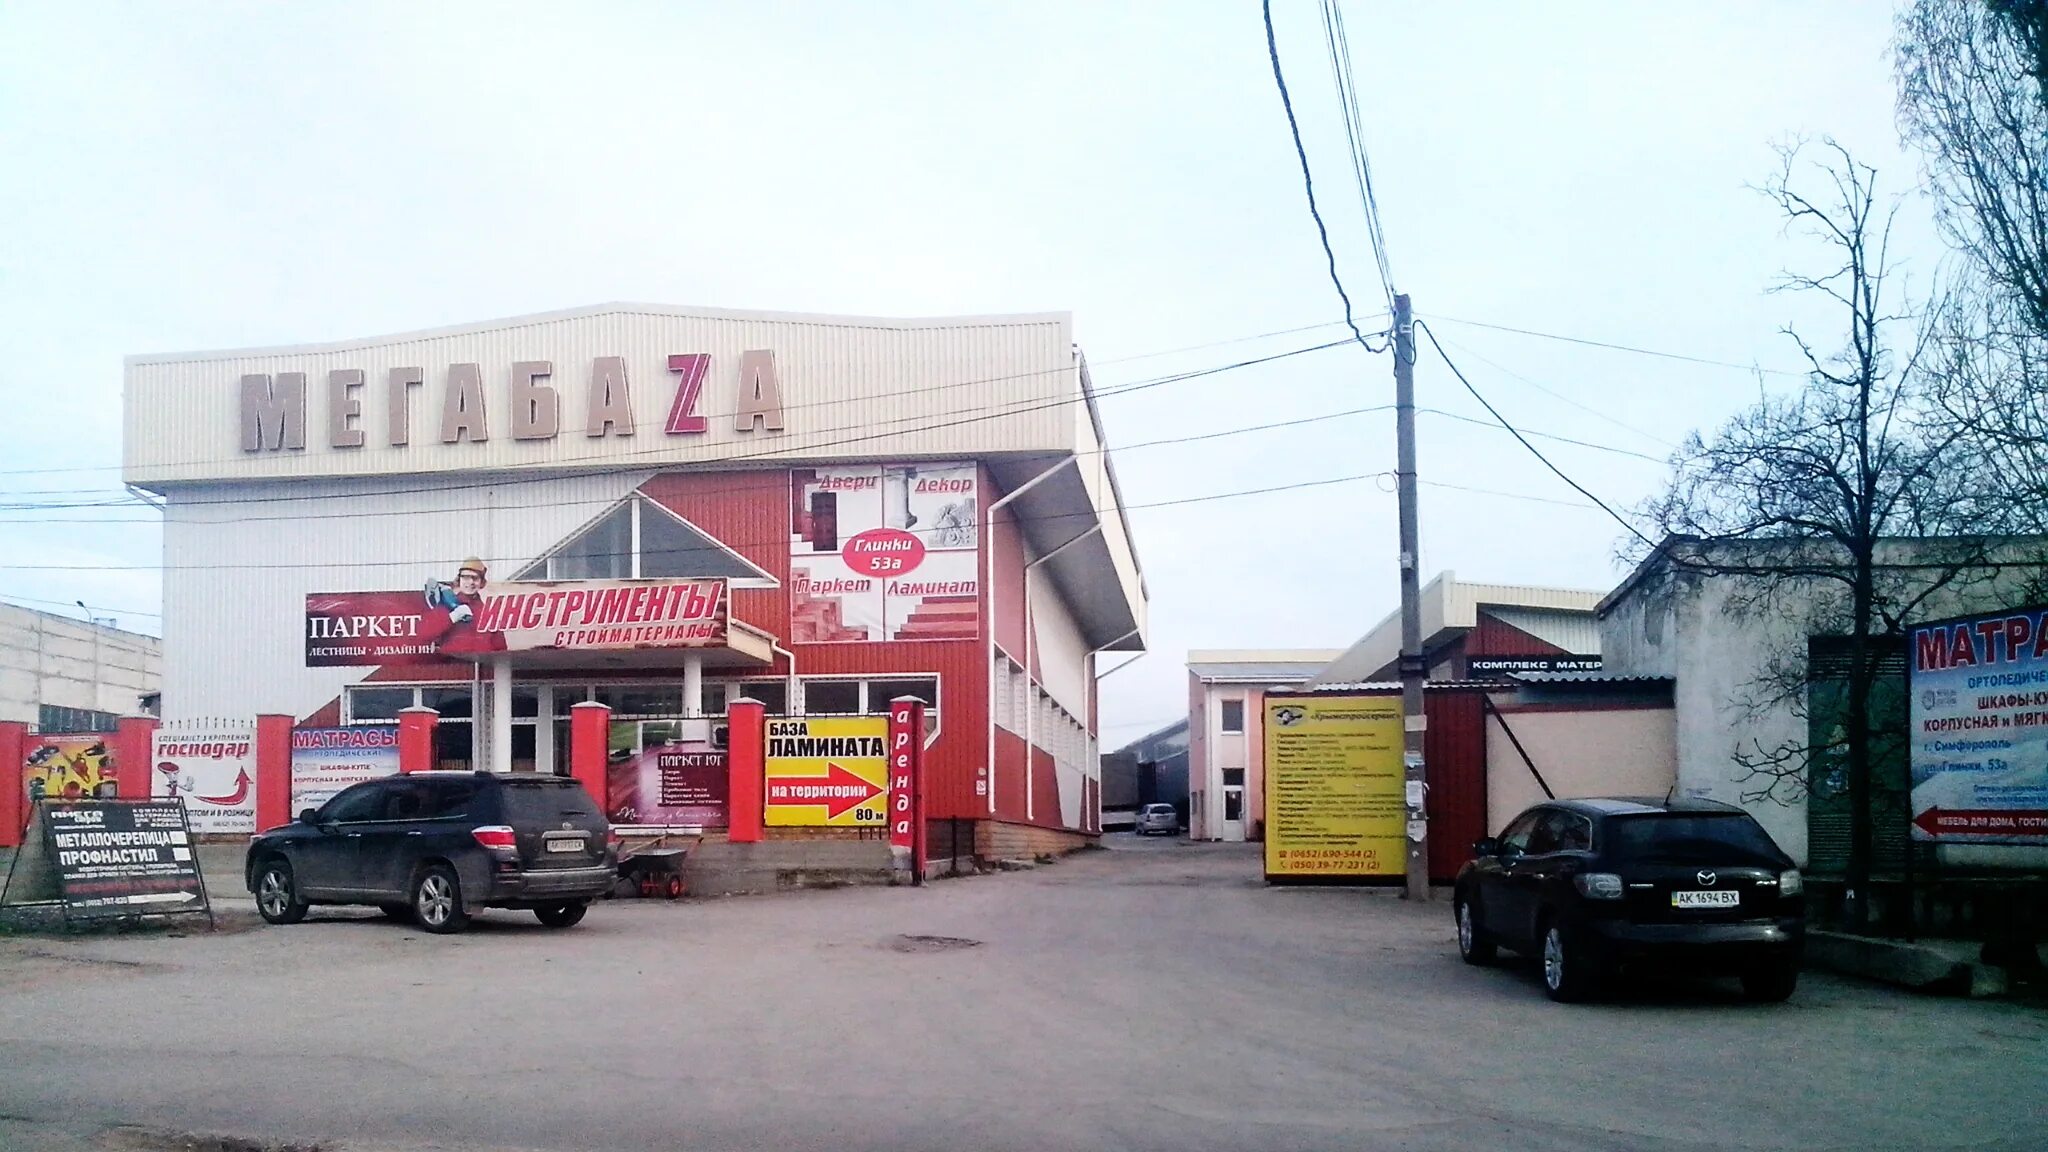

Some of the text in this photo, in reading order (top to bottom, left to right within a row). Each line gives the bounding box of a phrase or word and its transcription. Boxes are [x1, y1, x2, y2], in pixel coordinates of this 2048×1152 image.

[818, 474, 879, 491] Двери
[914, 477, 973, 495] Декор
[854, 538, 912, 553] Глинки
[870, 556, 903, 570] 53а
[795, 577, 872, 596] Паркет
[887, 579, 976, 596] Ламинат
[476, 581, 724, 633] ИНСТРУМЕНТЫ
[309, 614, 422, 640] ПАРКЕТ
[554, 622, 715, 647] СТРОЙМАТЕРИАЛЫ
[309, 646, 366, 657] ЛЕСТНИЦЫ
[373, 643, 416, 656] ДИЗАЙН
[1472, 661, 1602, 669] КОМПЛЕКС МАТЕР
[769, 722, 808, 736] БАЗА
[1924, 715, 1998, 733] КОРПУСНАЯ
[2002, 718, 2010, 726] и
[293, 729, 400, 748] МАТРАСЫ
[1934, 738, 2012, 753] Симферополь
[768, 737, 885, 758] ЛАМИНАТА
[660, 754, 724, 767] ПАРКЕТ ЮГ
[1987, 758, 2008, 771] 53а
[896, 710, 909, 834] аренда
[771, 785, 867, 799] на территории
[222, 809, 255, 817] РОЗНИЦУ
[856, 808, 873, 821] 80
[1937, 817, 1968, 826] МЕБЕЛЬ
[1970, 817, 1988, 827] ДЛЯ
[1989, 817, 2017, 828] ДОМА,
[55, 831, 171, 848] МЕТАЛЛОЧЕРЕПИЦА
[59, 848, 158, 866] ПРОФНАСТИЛ
[1290, 861, 1316, 870] (050)
[1679, 891, 1737, 904] AK 1694 BX
